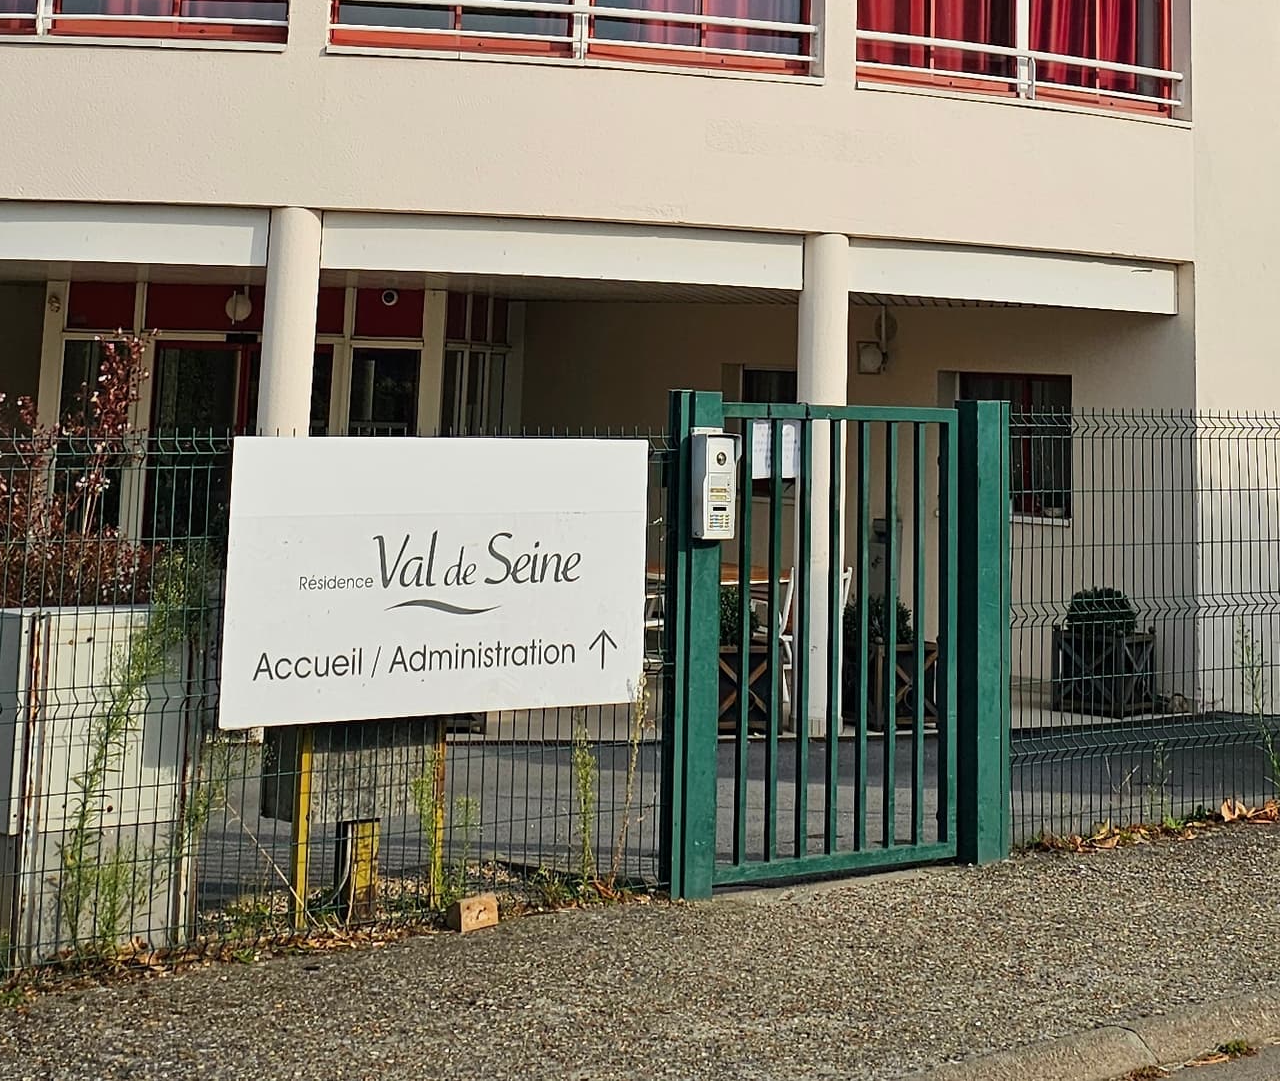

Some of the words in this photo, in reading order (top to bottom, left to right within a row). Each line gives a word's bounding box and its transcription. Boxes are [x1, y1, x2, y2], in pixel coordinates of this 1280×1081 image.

[298, 574, 374, 592] Résidence
[372, 529, 438, 590] Val
[443, 545, 477, 588] de
[483, 531, 582, 586] Seine
[252, 647, 363, 682] Accueil
[370, 646, 382, 679] /
[388, 638, 576, 674] Administration
